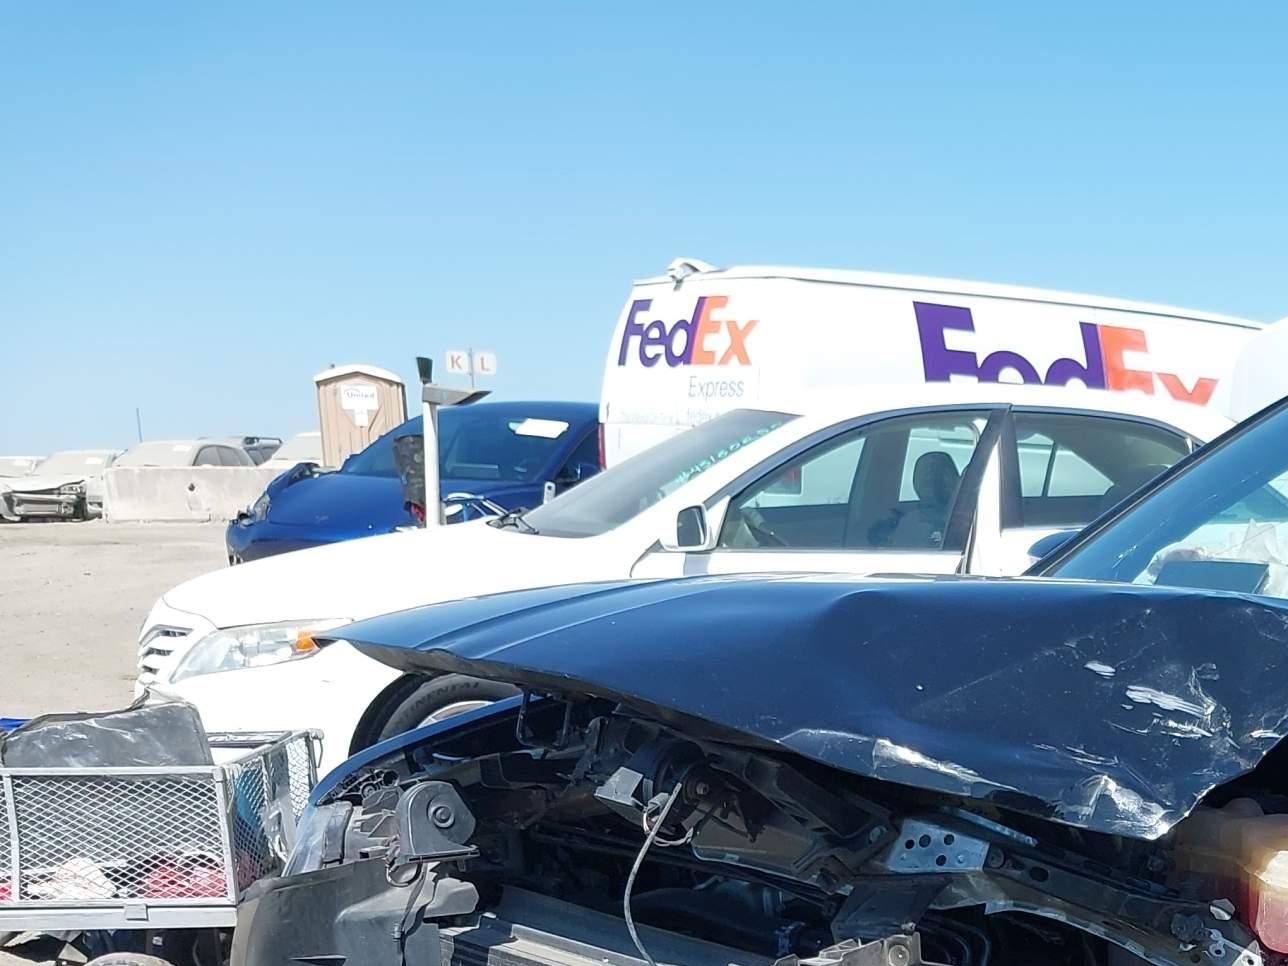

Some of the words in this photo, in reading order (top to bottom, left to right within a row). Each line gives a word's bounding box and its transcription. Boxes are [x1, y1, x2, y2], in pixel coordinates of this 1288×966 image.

[617, 295, 760, 367] FedEx
[450, 355, 462, 369] K
[480, 356, 491, 371] L
[688, 375, 746, 403] Express
